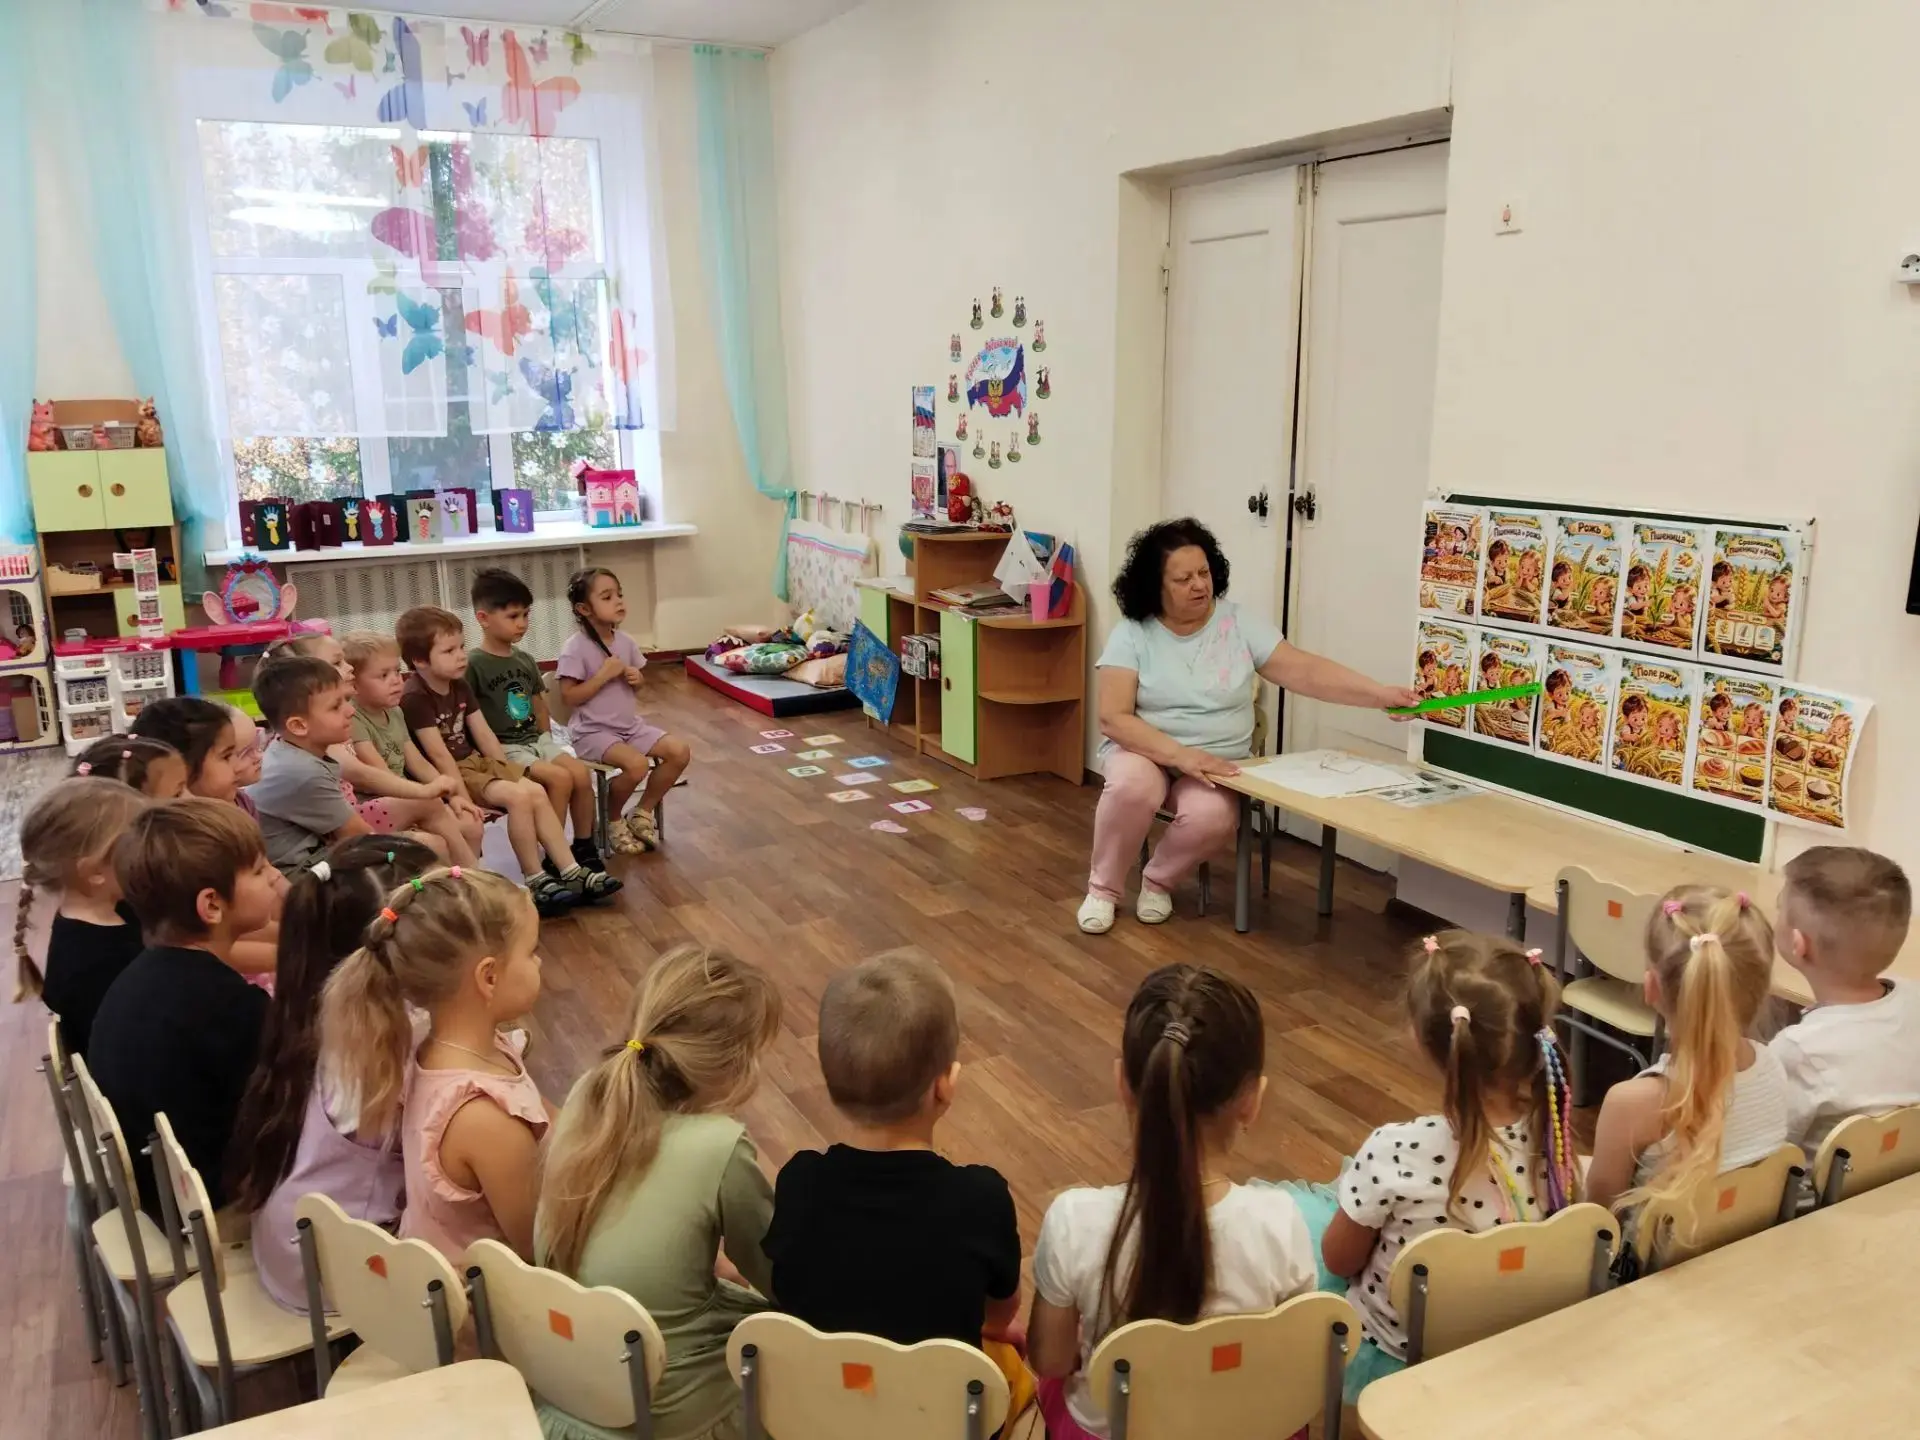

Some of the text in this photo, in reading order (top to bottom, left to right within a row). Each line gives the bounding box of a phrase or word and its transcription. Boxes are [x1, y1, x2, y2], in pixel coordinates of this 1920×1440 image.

[1578, 521, 1601, 534] Рожь
[1650, 530, 1686, 544] Пшеница
[1636, 667, 1678, 683] Поле ржи
[764, 730, 790, 738] 10
[798, 766, 818, 775] 5
